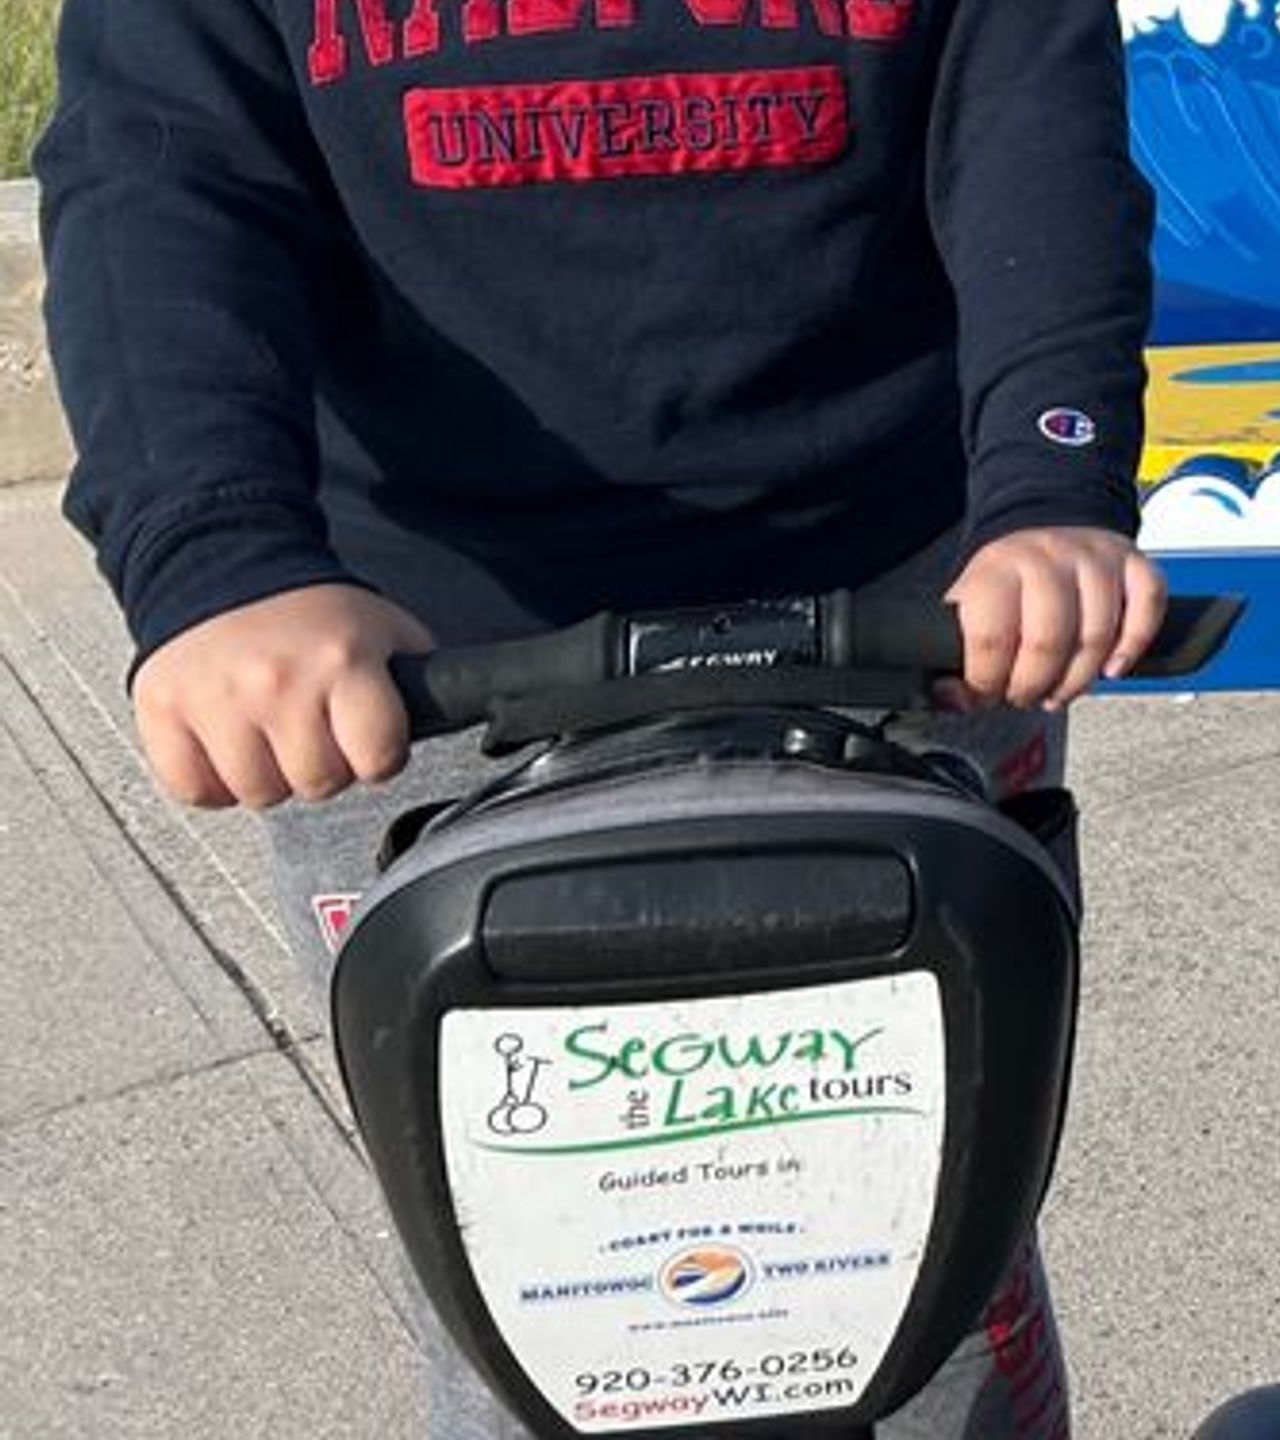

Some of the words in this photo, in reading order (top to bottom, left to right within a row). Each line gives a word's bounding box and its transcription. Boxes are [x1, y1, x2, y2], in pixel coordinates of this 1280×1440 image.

[428, 90, 832, 166] UNIVERSITY
[618, 1090, 649, 1130] the
[809, 1071, 913, 1102] tours
[598, 1164, 688, 1192] Guided
[698, 1161, 769, 1182] Tours
[574, 1346, 859, 1396] 920-376-0256
[574, 1377, 855, 1422] SegwayWI.com
